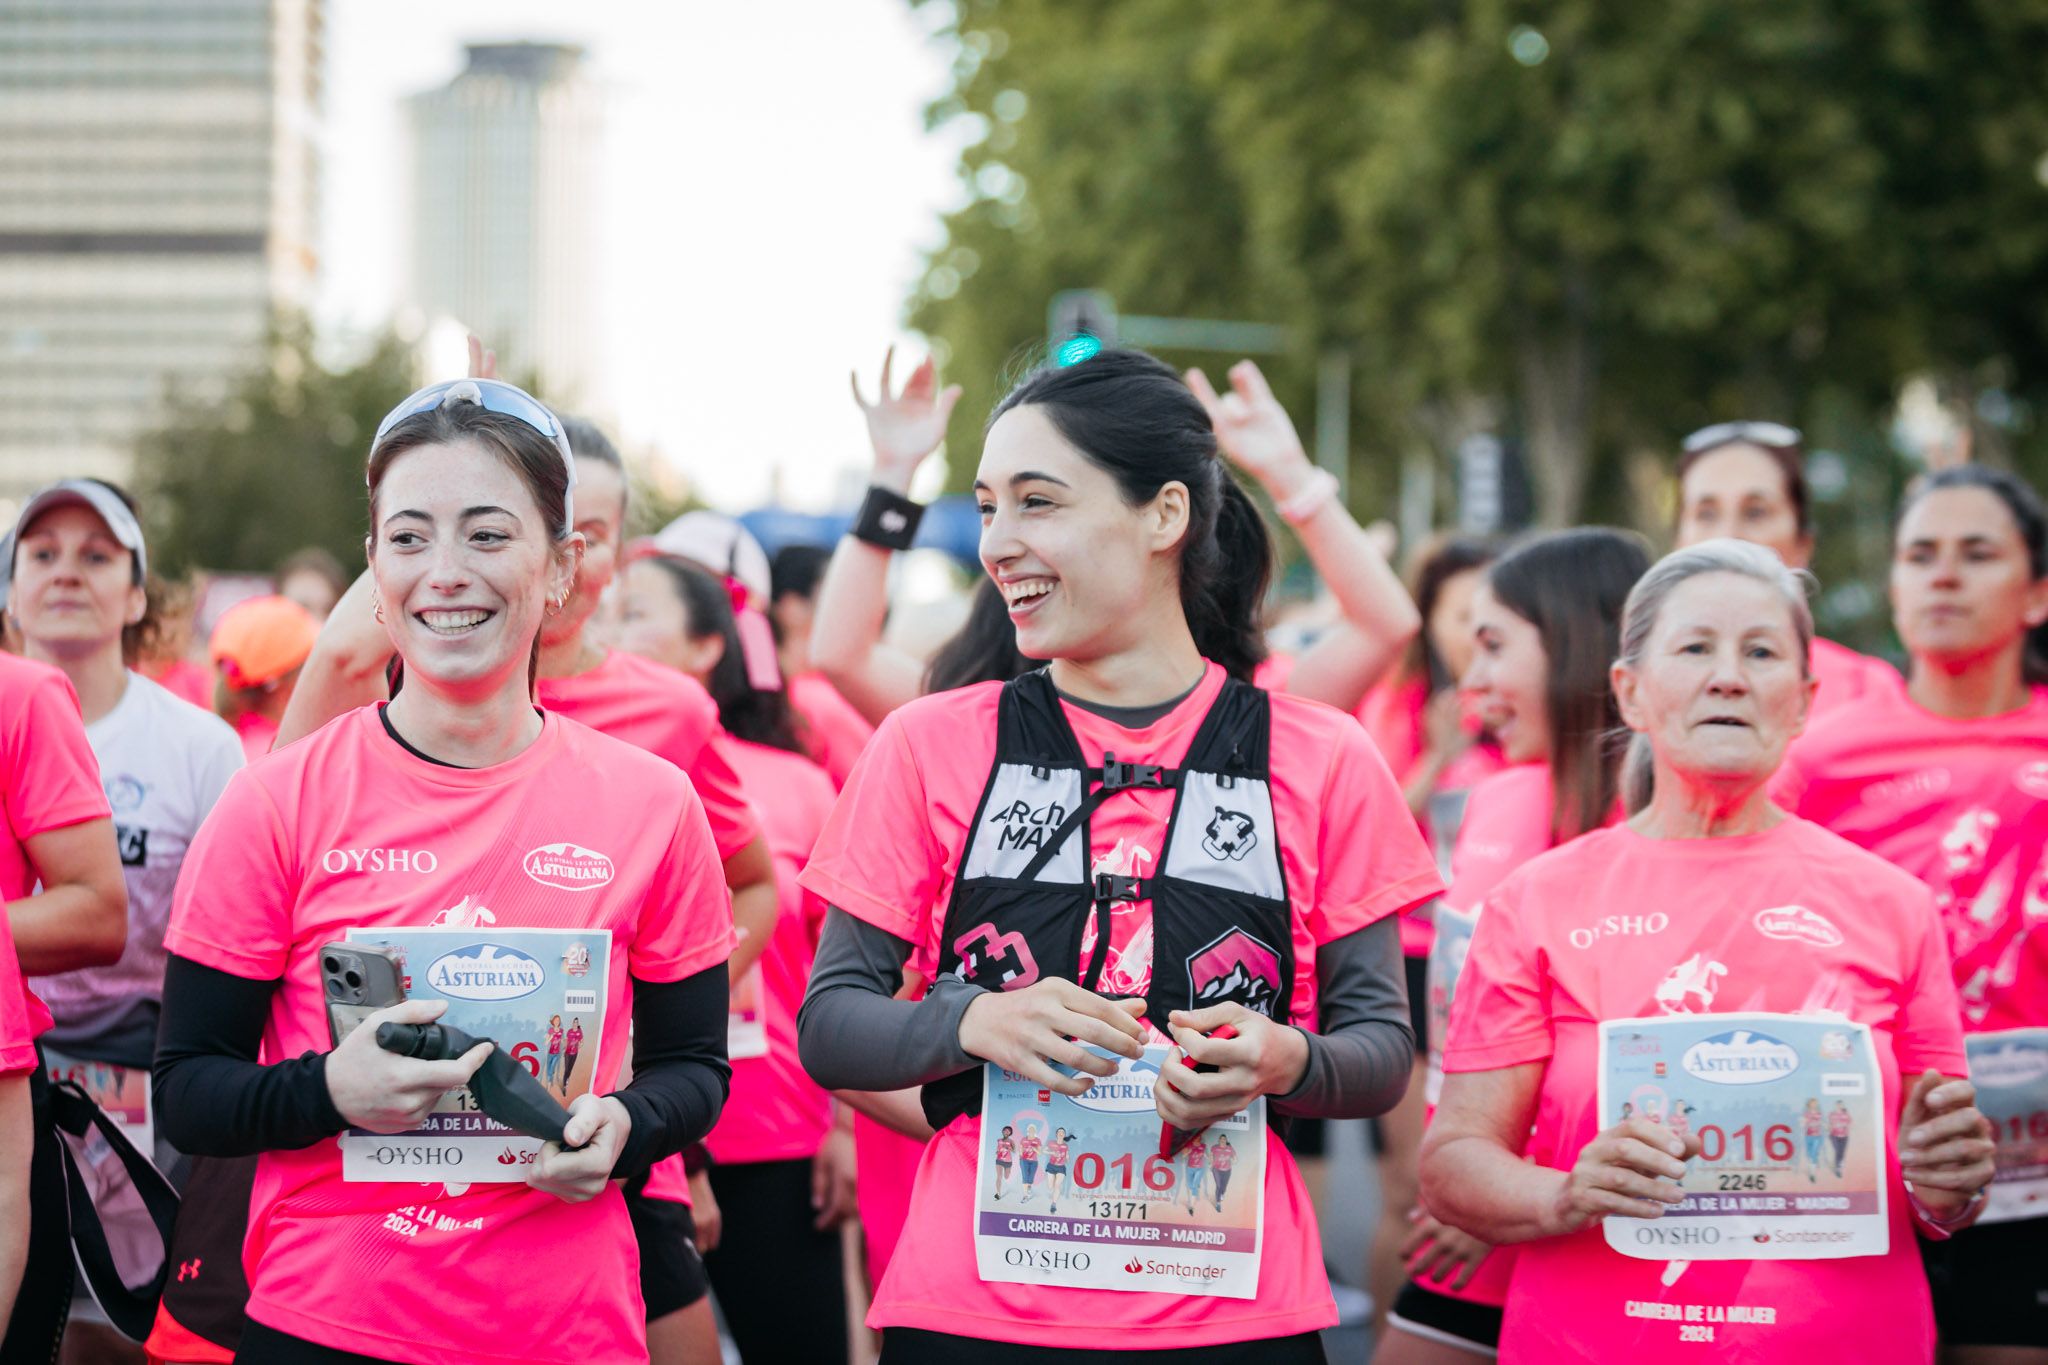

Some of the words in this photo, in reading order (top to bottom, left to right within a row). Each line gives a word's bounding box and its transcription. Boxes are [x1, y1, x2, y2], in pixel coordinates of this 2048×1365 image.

[322, 848, 438, 873] OYSHO
[531, 856, 609, 879] ASTURIANA
[435, 964, 537, 987] ASTURIANA
[1690, 1053, 1792, 1073] ASTURIANA
[1002, 1069, 1032, 1081] SU
[1074, 1084, 1153, 1100] STURIA
[443, 1118, 461, 1131] DE
[464, 1118, 482, 1131] LA
[1697, 1124, 1795, 1162] 016
[376, 1146, 463, 1165] OYSHO
[1073, 1152, 1176, 1191] 016
[1718, 1174, 1767, 1191] 2246
[1088, 1201, 1147, 1220] 13171
[1700, 1197, 1718, 1210] DE
[1720, 1197, 1738, 1210] LA
[1740, 1197, 1787, 1210] MUJER
[383, 1212, 419, 1237] 2024
[416, 1205, 437, 1227] LA
[1008, 1218, 1070, 1235] CARRERA
[1073, 1223, 1091, 1237] DE
[1094, 1224, 1112, 1238] LA
[1115, 1226, 1160, 1241] MUJER
[1171, 1230, 1226, 1245] MADRID
[1635, 1227, 1720, 1245] OYSHO
[1775, 1229, 1856, 1243] Santander
[1005, 1247, 1091, 1271] OYSHO
[1146, 1259, 1226, 1280] Santander
[1625, 1300, 1683, 1321] CARRERA
[1684, 1304, 1705, 1322] DE
[1706, 1305, 1725, 1323] LA
[1726, 1305, 1777, 1325] MUJER
[1679, 1324, 1715, 1342] 2024
